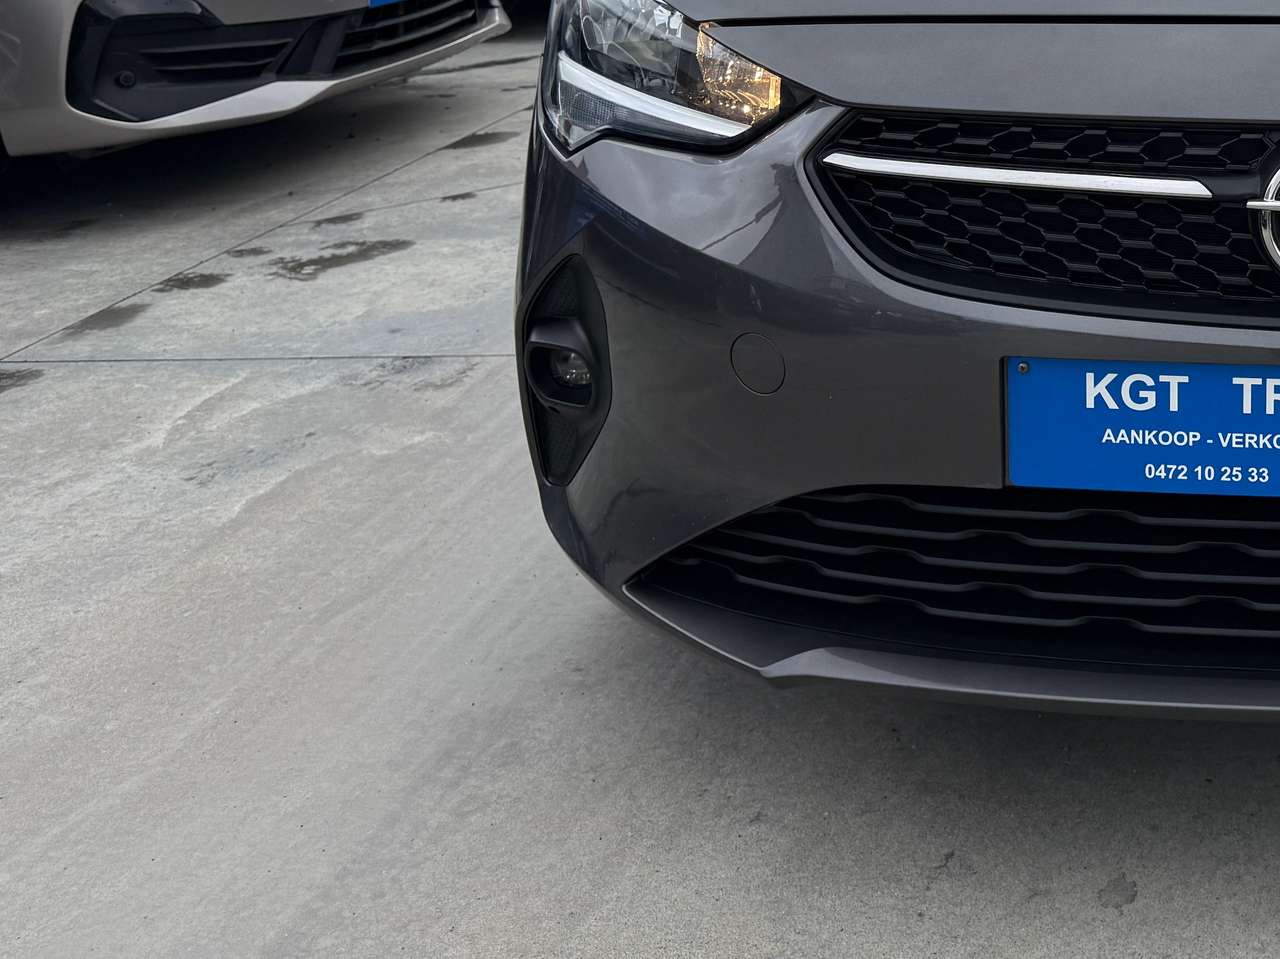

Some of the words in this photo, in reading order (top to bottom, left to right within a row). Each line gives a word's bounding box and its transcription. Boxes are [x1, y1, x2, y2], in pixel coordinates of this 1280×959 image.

[1085, 372, 1189, 411] KGT
[1101, 428, 1201, 447] AANKOOP
[1144, 463, 1188, 480] 0472
[1194, 465, 1215, 481] 10
[1220, 466, 1242, 482] 25
[1247, 467, 1269, 483] 33
